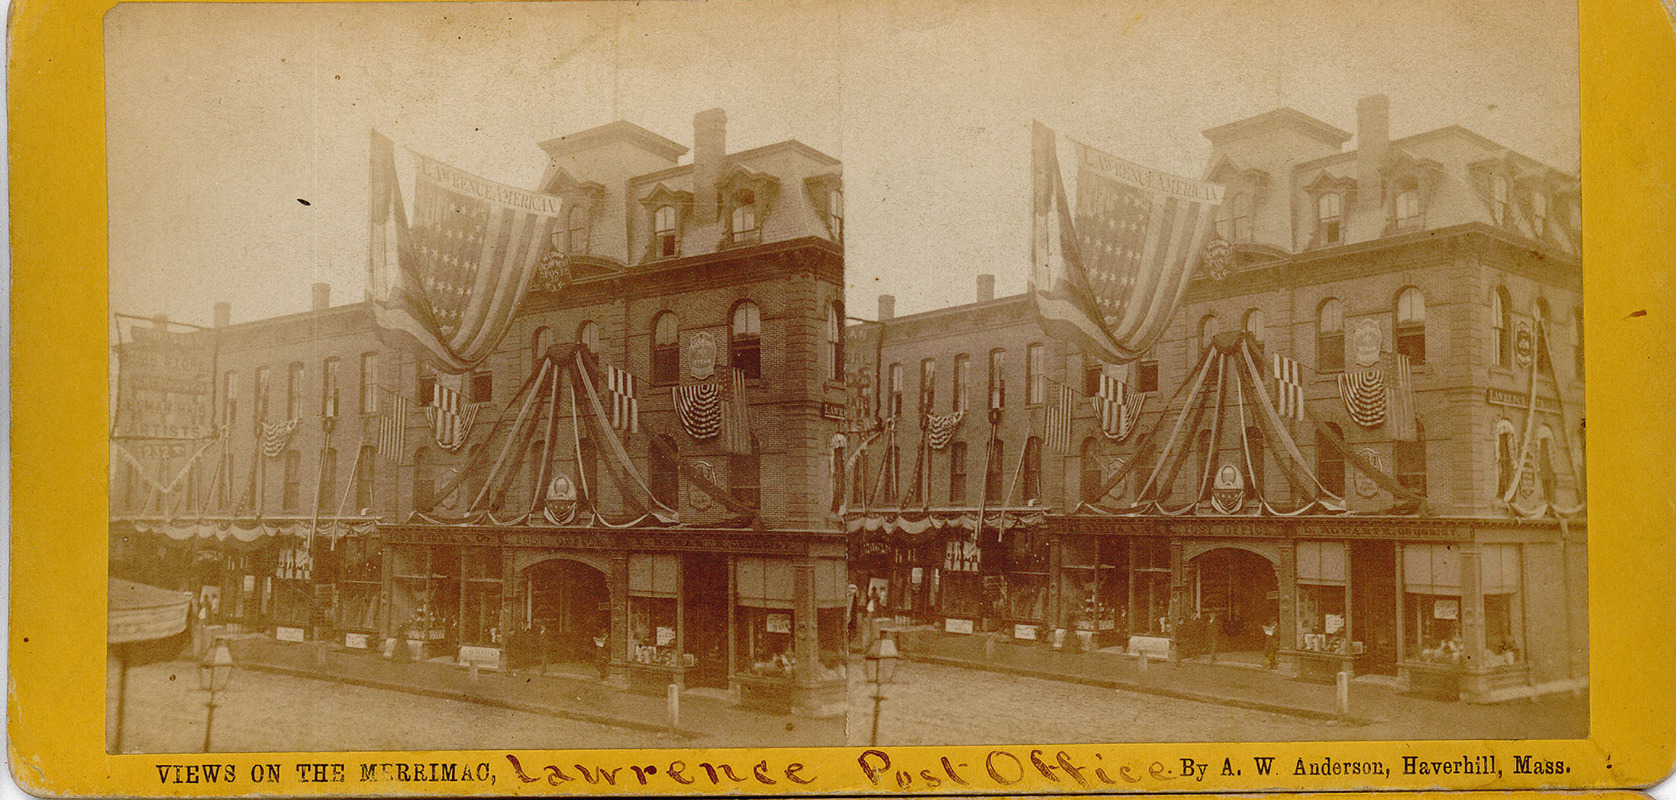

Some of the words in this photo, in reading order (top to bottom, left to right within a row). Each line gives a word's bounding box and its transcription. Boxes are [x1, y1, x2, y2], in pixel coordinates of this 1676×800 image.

[421, 157, 493, 200] LAWRENCE
[494, 184, 556, 213] AMERICAN
[1083, 146, 1151, 187] LAWRENCE
[1157, 176, 1217, 201] AMERICAN
[156, 764, 236, 784] VIEWS
[250, 764, 281, 784] ON
[296, 763, 345, 783] THE
[360, 763, 496, 785] MERRIMAC,
[858, 749, 970, 790] Post
[1180, 757, 1208, 781] By
[1220, 757, 1241, 776] A.
[1293, 757, 1390, 779] Anderson,
[1402, 756, 1503, 779] Haverhill,
[1513, 756, 1571, 774] Mass.
